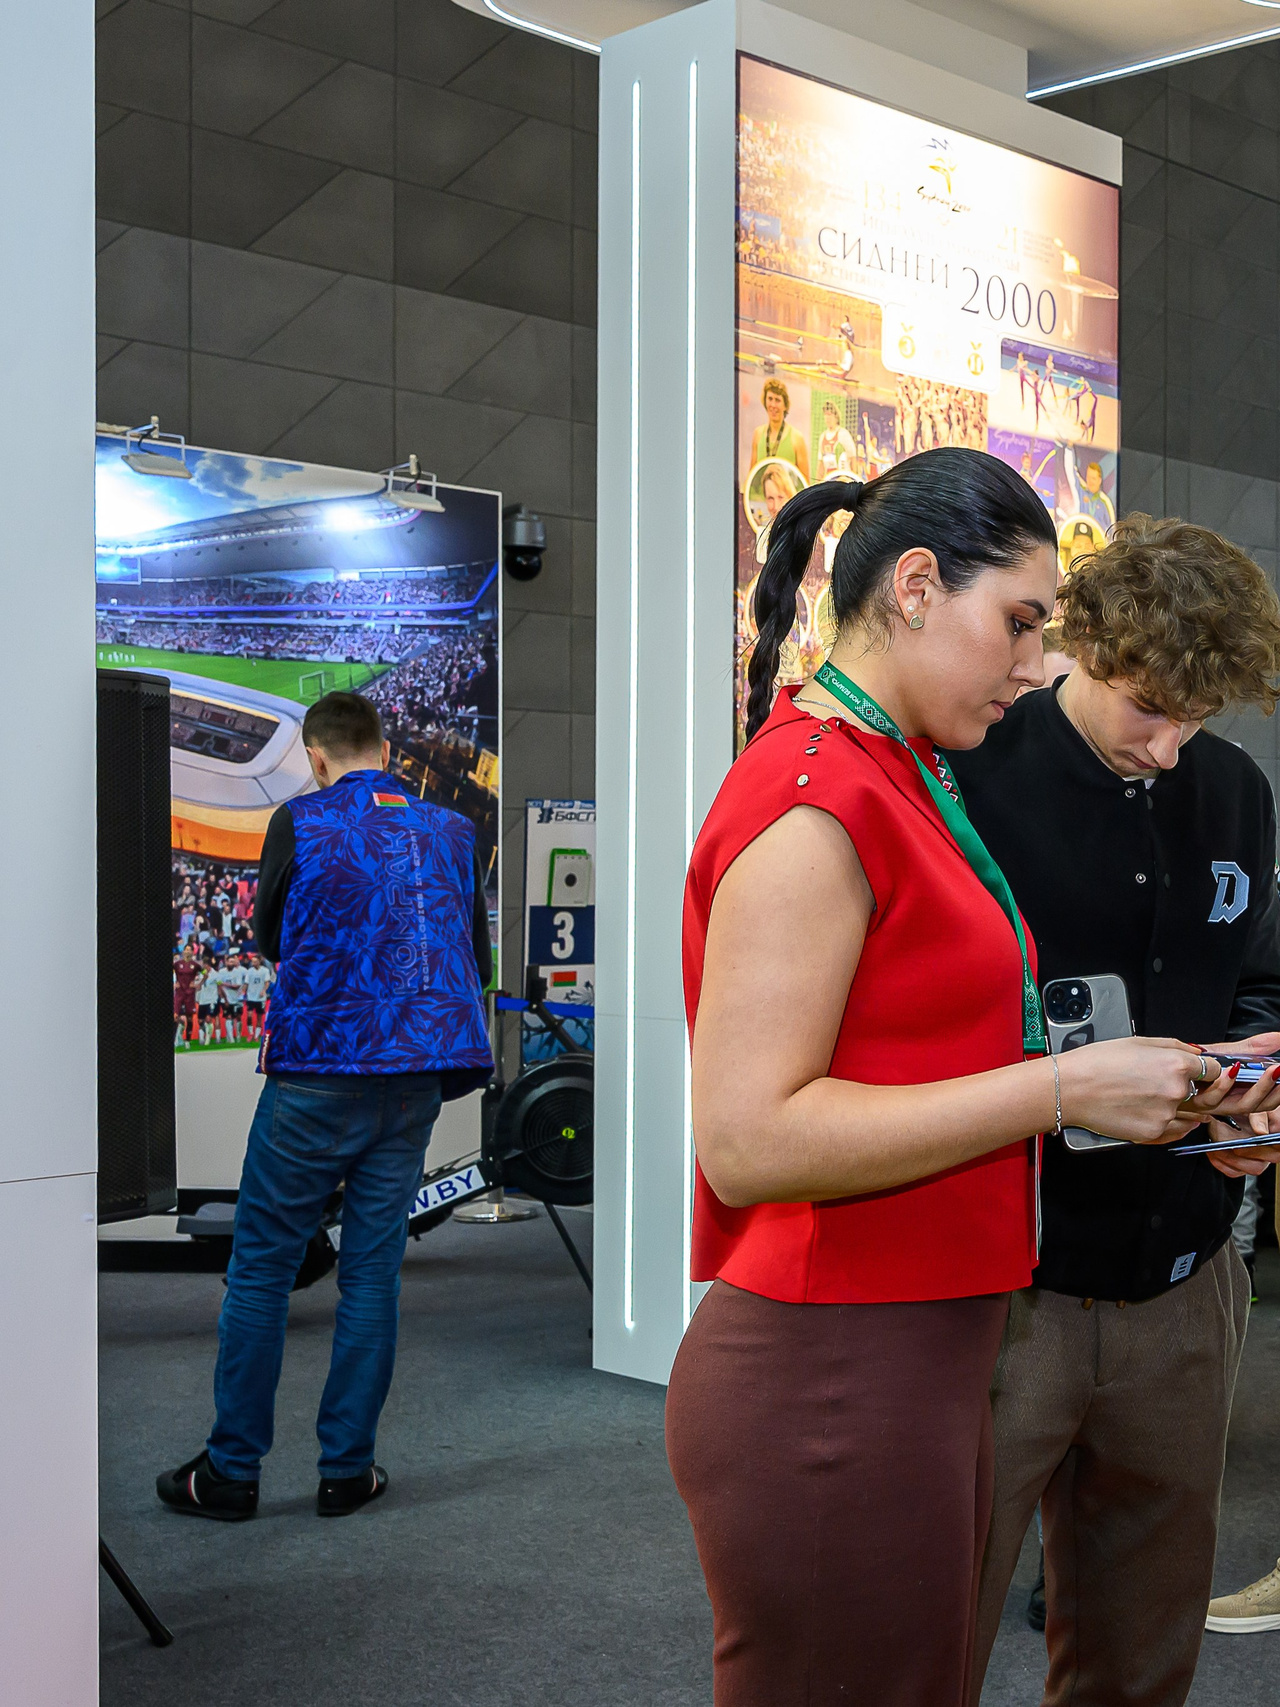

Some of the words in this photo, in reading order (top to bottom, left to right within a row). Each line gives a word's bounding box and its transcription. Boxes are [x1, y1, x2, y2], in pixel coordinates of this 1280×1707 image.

[817, 226, 950, 290] СИДНЕЙ
[960, 266, 1058, 335] 2000
[382, 830, 419, 996] KOMPAK
[551, 911, 575, 959] 3
[1208, 861, 1250, 924] D
